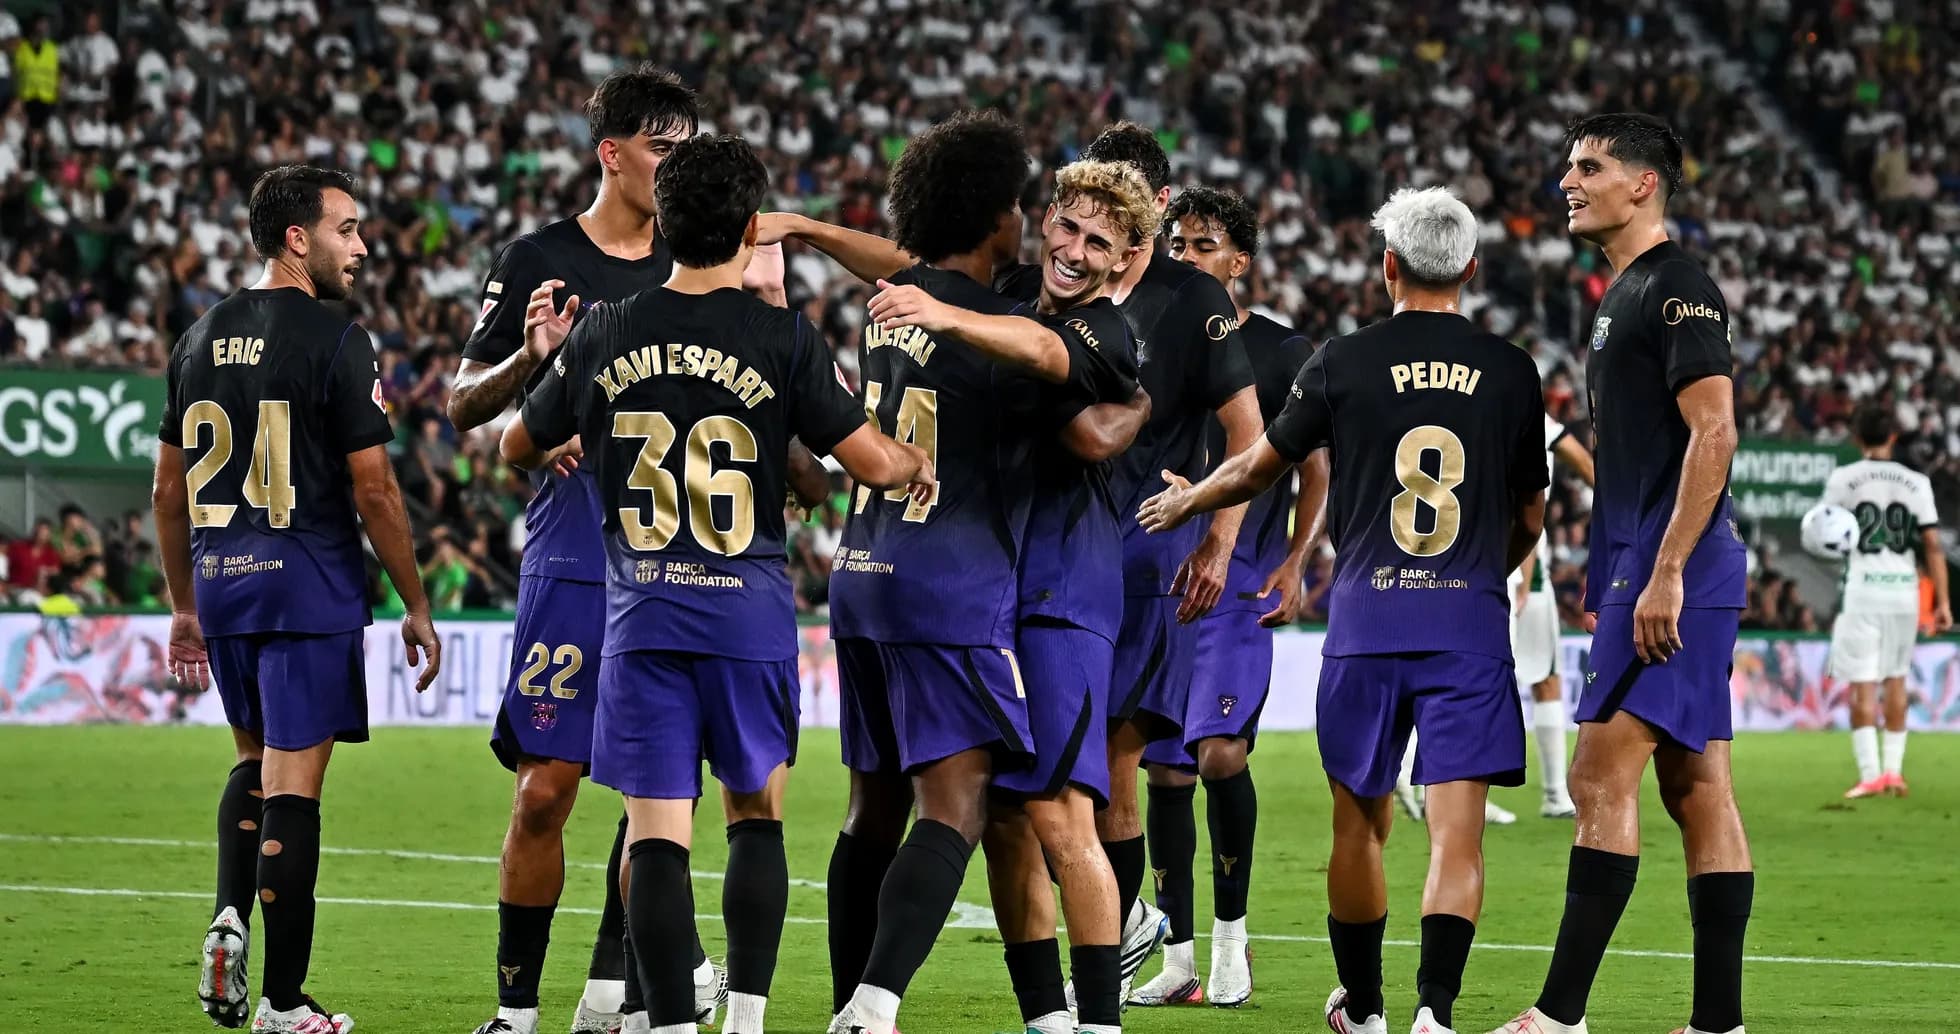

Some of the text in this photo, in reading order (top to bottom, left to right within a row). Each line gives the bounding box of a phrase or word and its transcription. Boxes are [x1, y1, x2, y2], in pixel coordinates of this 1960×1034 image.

[1663, 298, 1720, 325] Midea
[213, 337, 265, 366] ERIC
[594, 343, 775, 409] XAVI ESPART
[1390, 361, 1482, 395] PEDRI
[183, 400, 295, 528] 24
[612, 412, 758, 557] 36
[1390, 425, 1465, 556] 8
[1856, 501, 1911, 554] 29
[224, 555, 253, 566] BARÇA
[845, 560, 893, 574] FOUNDATION
[849, 549, 871, 560] BARÇA
[223, 560, 283, 577] FOUNDATION
[664, 573, 743, 588] FOUNDATION
[666, 562, 706, 576] BARÇA
[1400, 568, 1436, 580] BARÇA
[1399, 579, 1468, 589] FOUNDATION
[518, 642, 583, 699] 22
